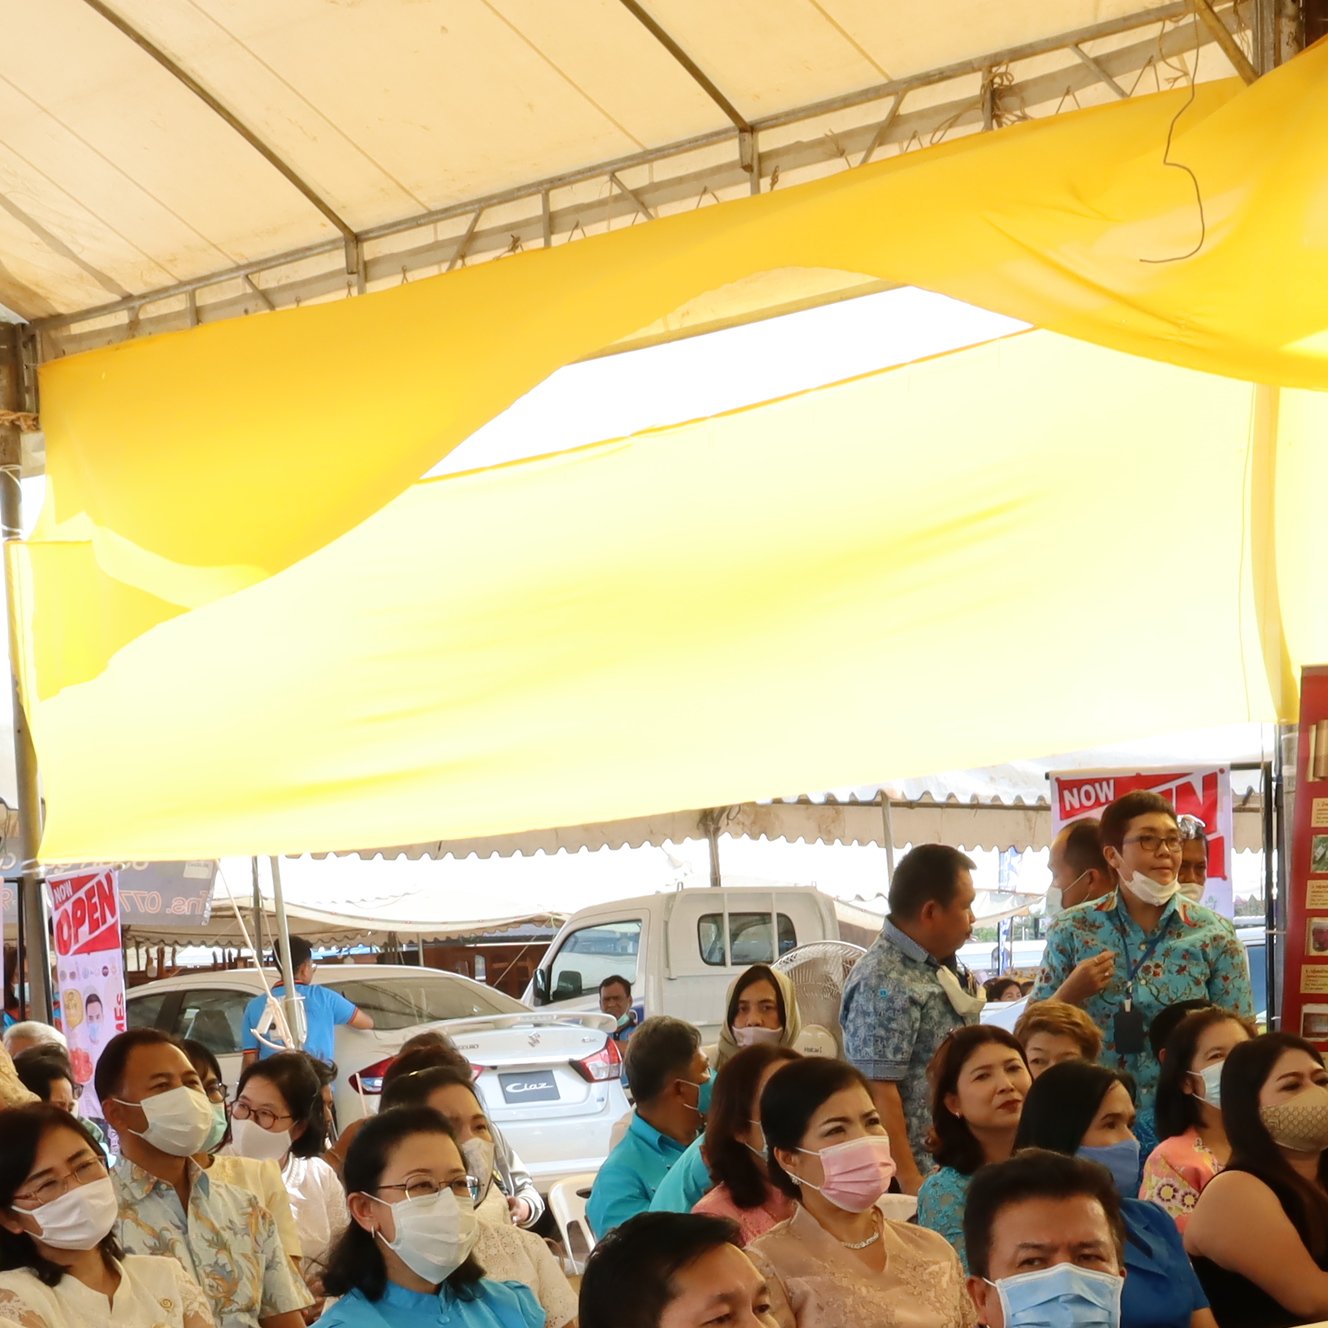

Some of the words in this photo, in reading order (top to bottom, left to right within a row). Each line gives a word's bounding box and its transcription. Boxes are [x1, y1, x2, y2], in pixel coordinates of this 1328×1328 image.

[1062, 779, 1115, 811] NOW
[53, 880, 72, 902] NOW
[55, 870, 118, 956] OPEN
